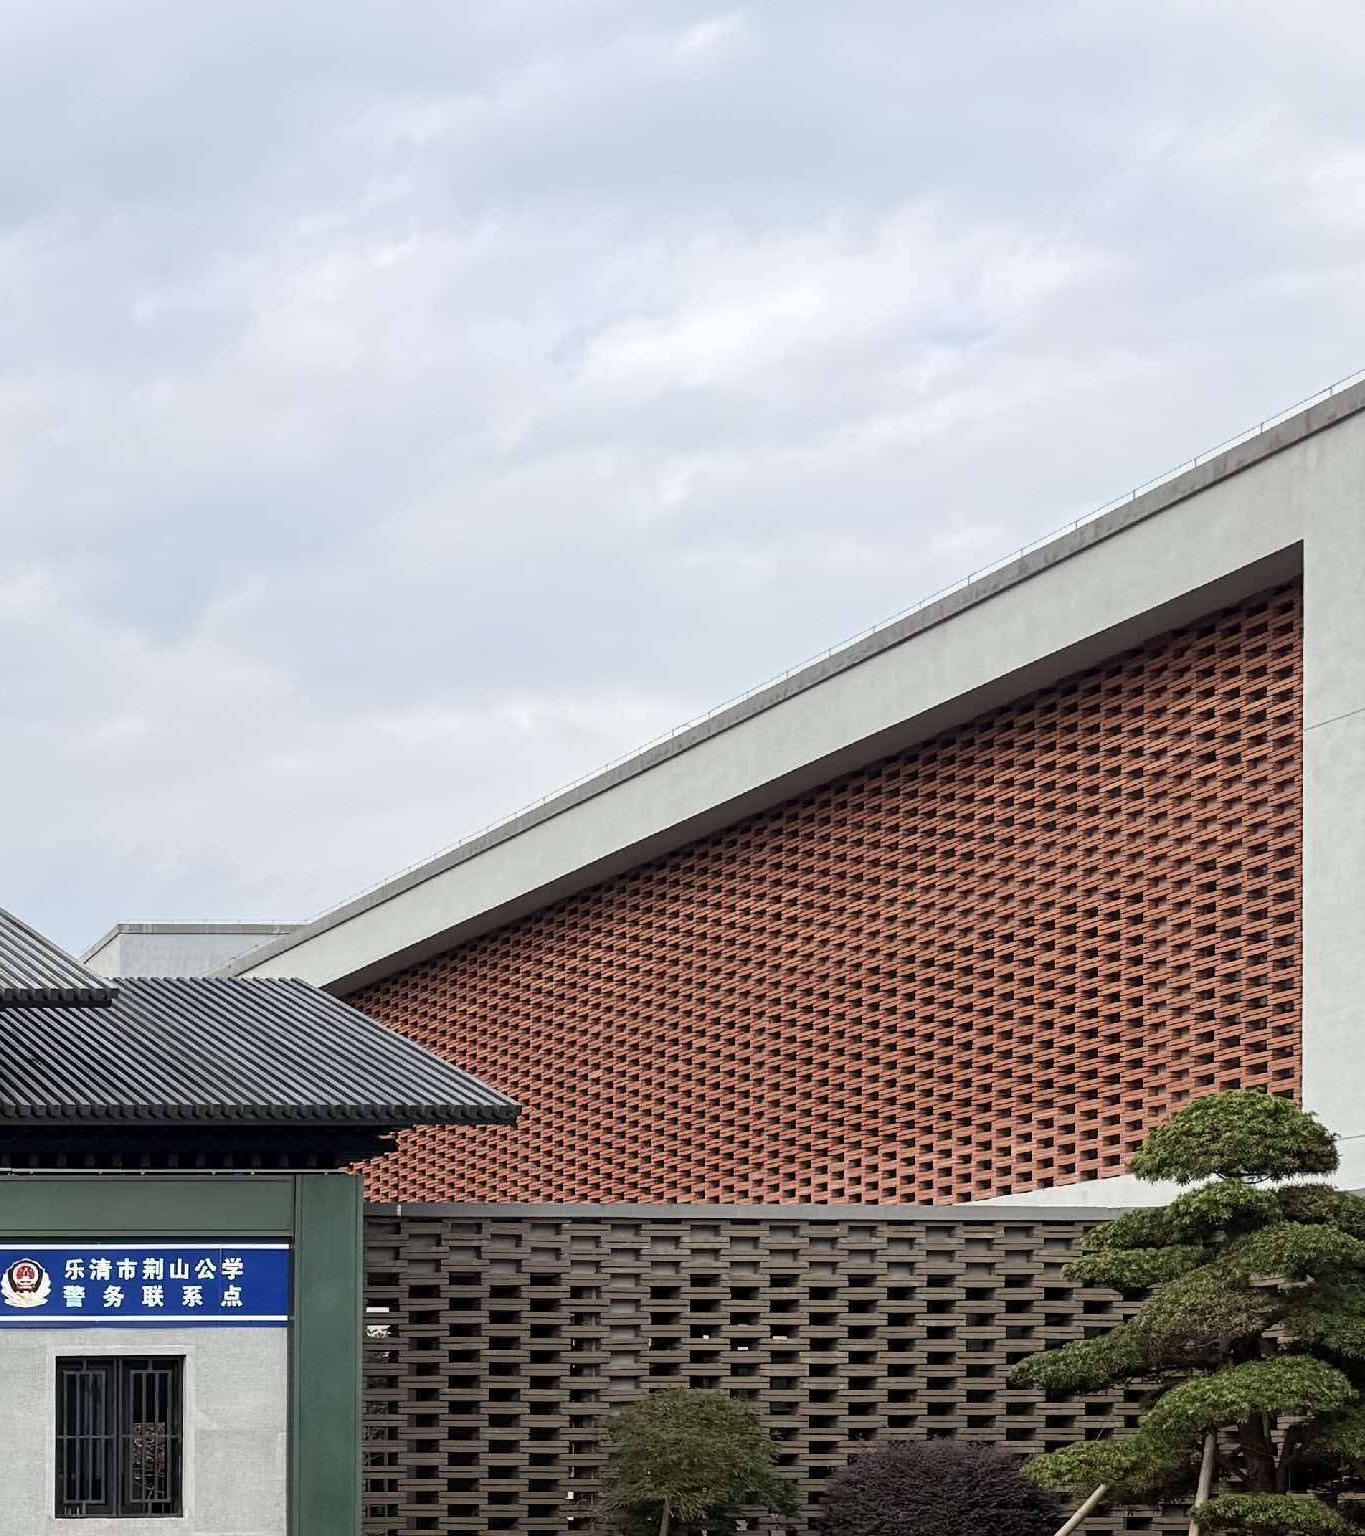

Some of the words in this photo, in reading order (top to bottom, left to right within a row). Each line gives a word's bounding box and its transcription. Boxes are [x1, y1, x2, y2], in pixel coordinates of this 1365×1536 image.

[64, 1257, 244, 1281] 乐清市荆山公学
[62, 1284, 244, 1308] 警务联系点
